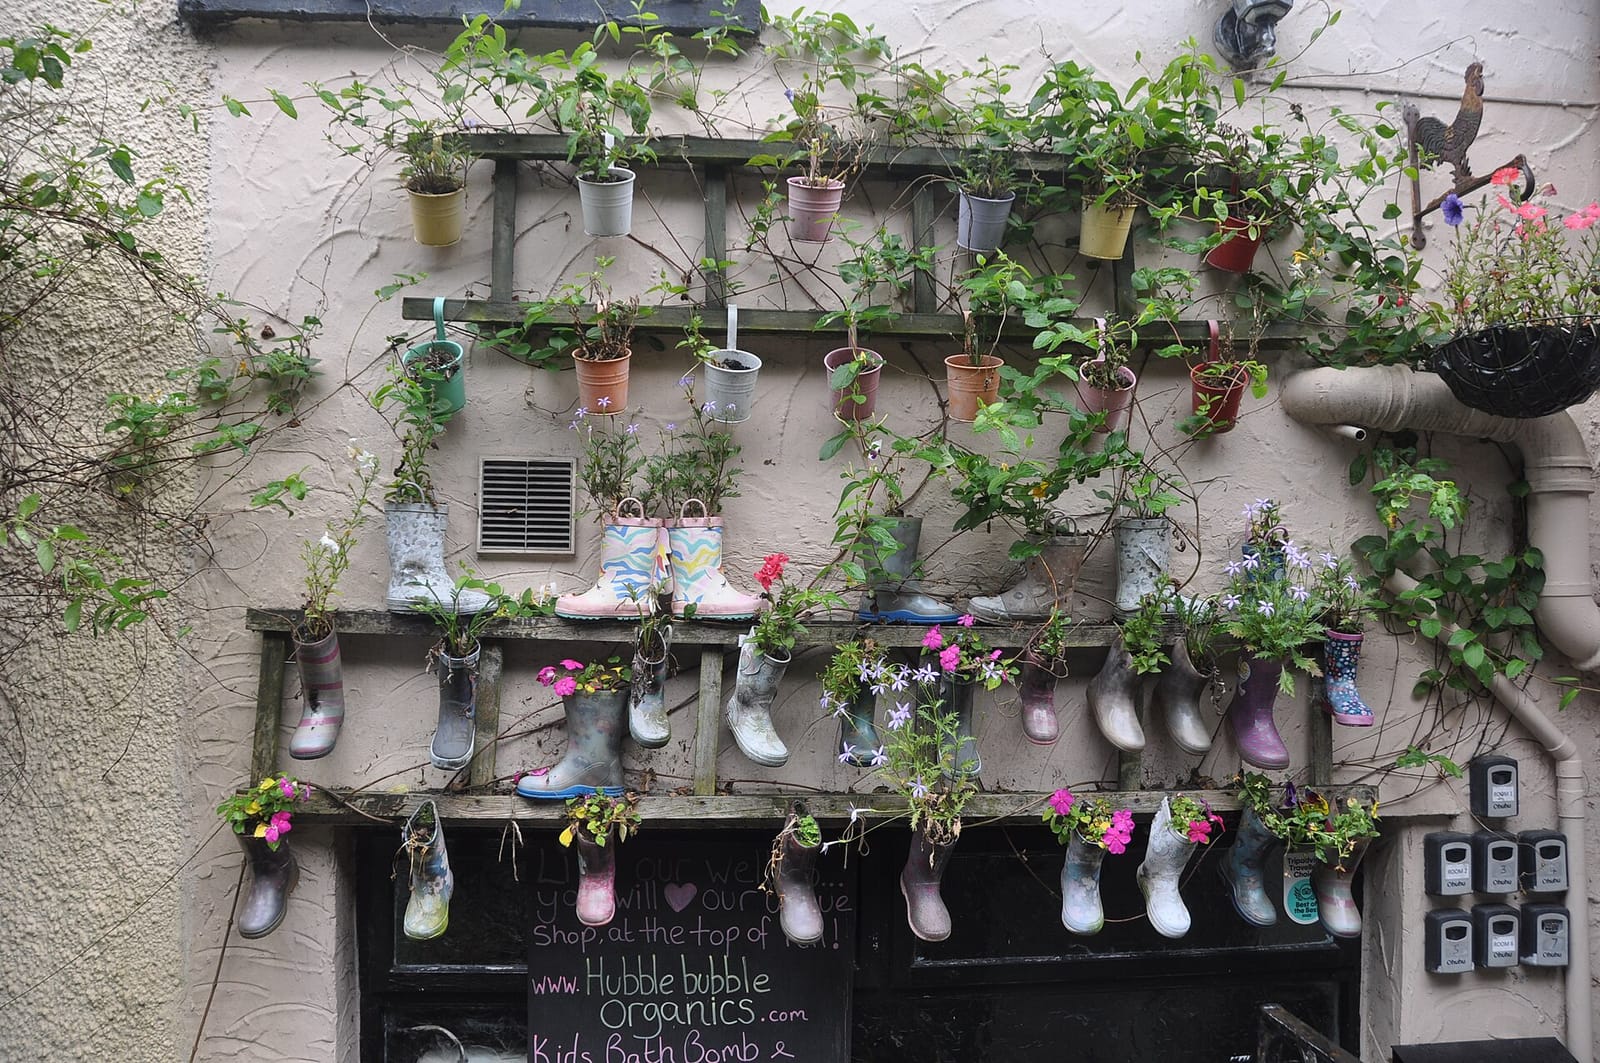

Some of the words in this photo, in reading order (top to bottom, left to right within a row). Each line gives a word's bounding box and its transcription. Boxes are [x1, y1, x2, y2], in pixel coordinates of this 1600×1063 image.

[536, 890, 577, 924] yo
[615, 879, 657, 910] will
[702, 889, 758, 912] our
[608, 917, 635, 942] at
[638, 916, 685, 945] the
[689, 915, 740, 957] top
[746, 915, 772, 950] of
[532, 975, 580, 995] www.
[585, 955, 674, 996] Hubble
[681, 954, 771, 996] bubble
[532, 1032, 591, 1063] Kids
[606, 1033, 674, 1063] Bath
[683, 1030, 759, 1063] Bomb
